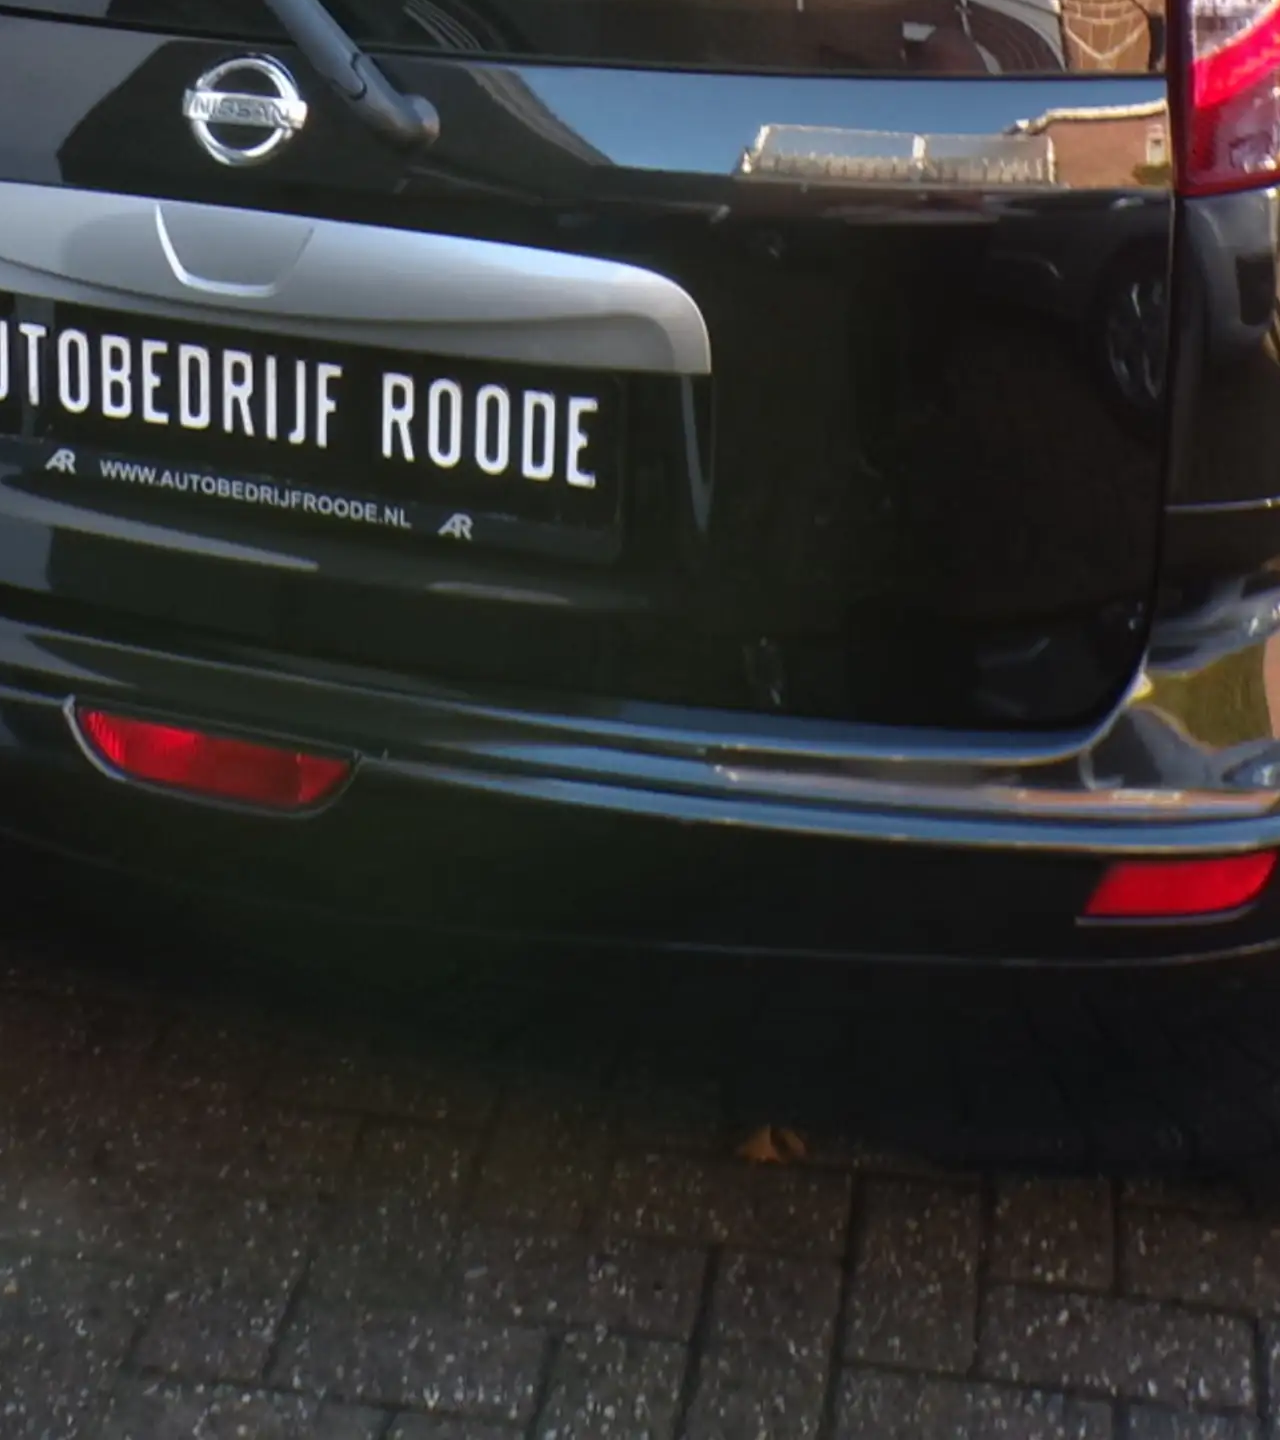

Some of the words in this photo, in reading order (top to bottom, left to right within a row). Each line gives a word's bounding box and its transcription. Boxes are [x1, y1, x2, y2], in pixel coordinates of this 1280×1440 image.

[191, 92, 297, 130] NISSAN
[381, 371, 599, 488] ROODE
[99, 460, 413, 529] WWW.AUTOBEDRIJFROODE.NL
